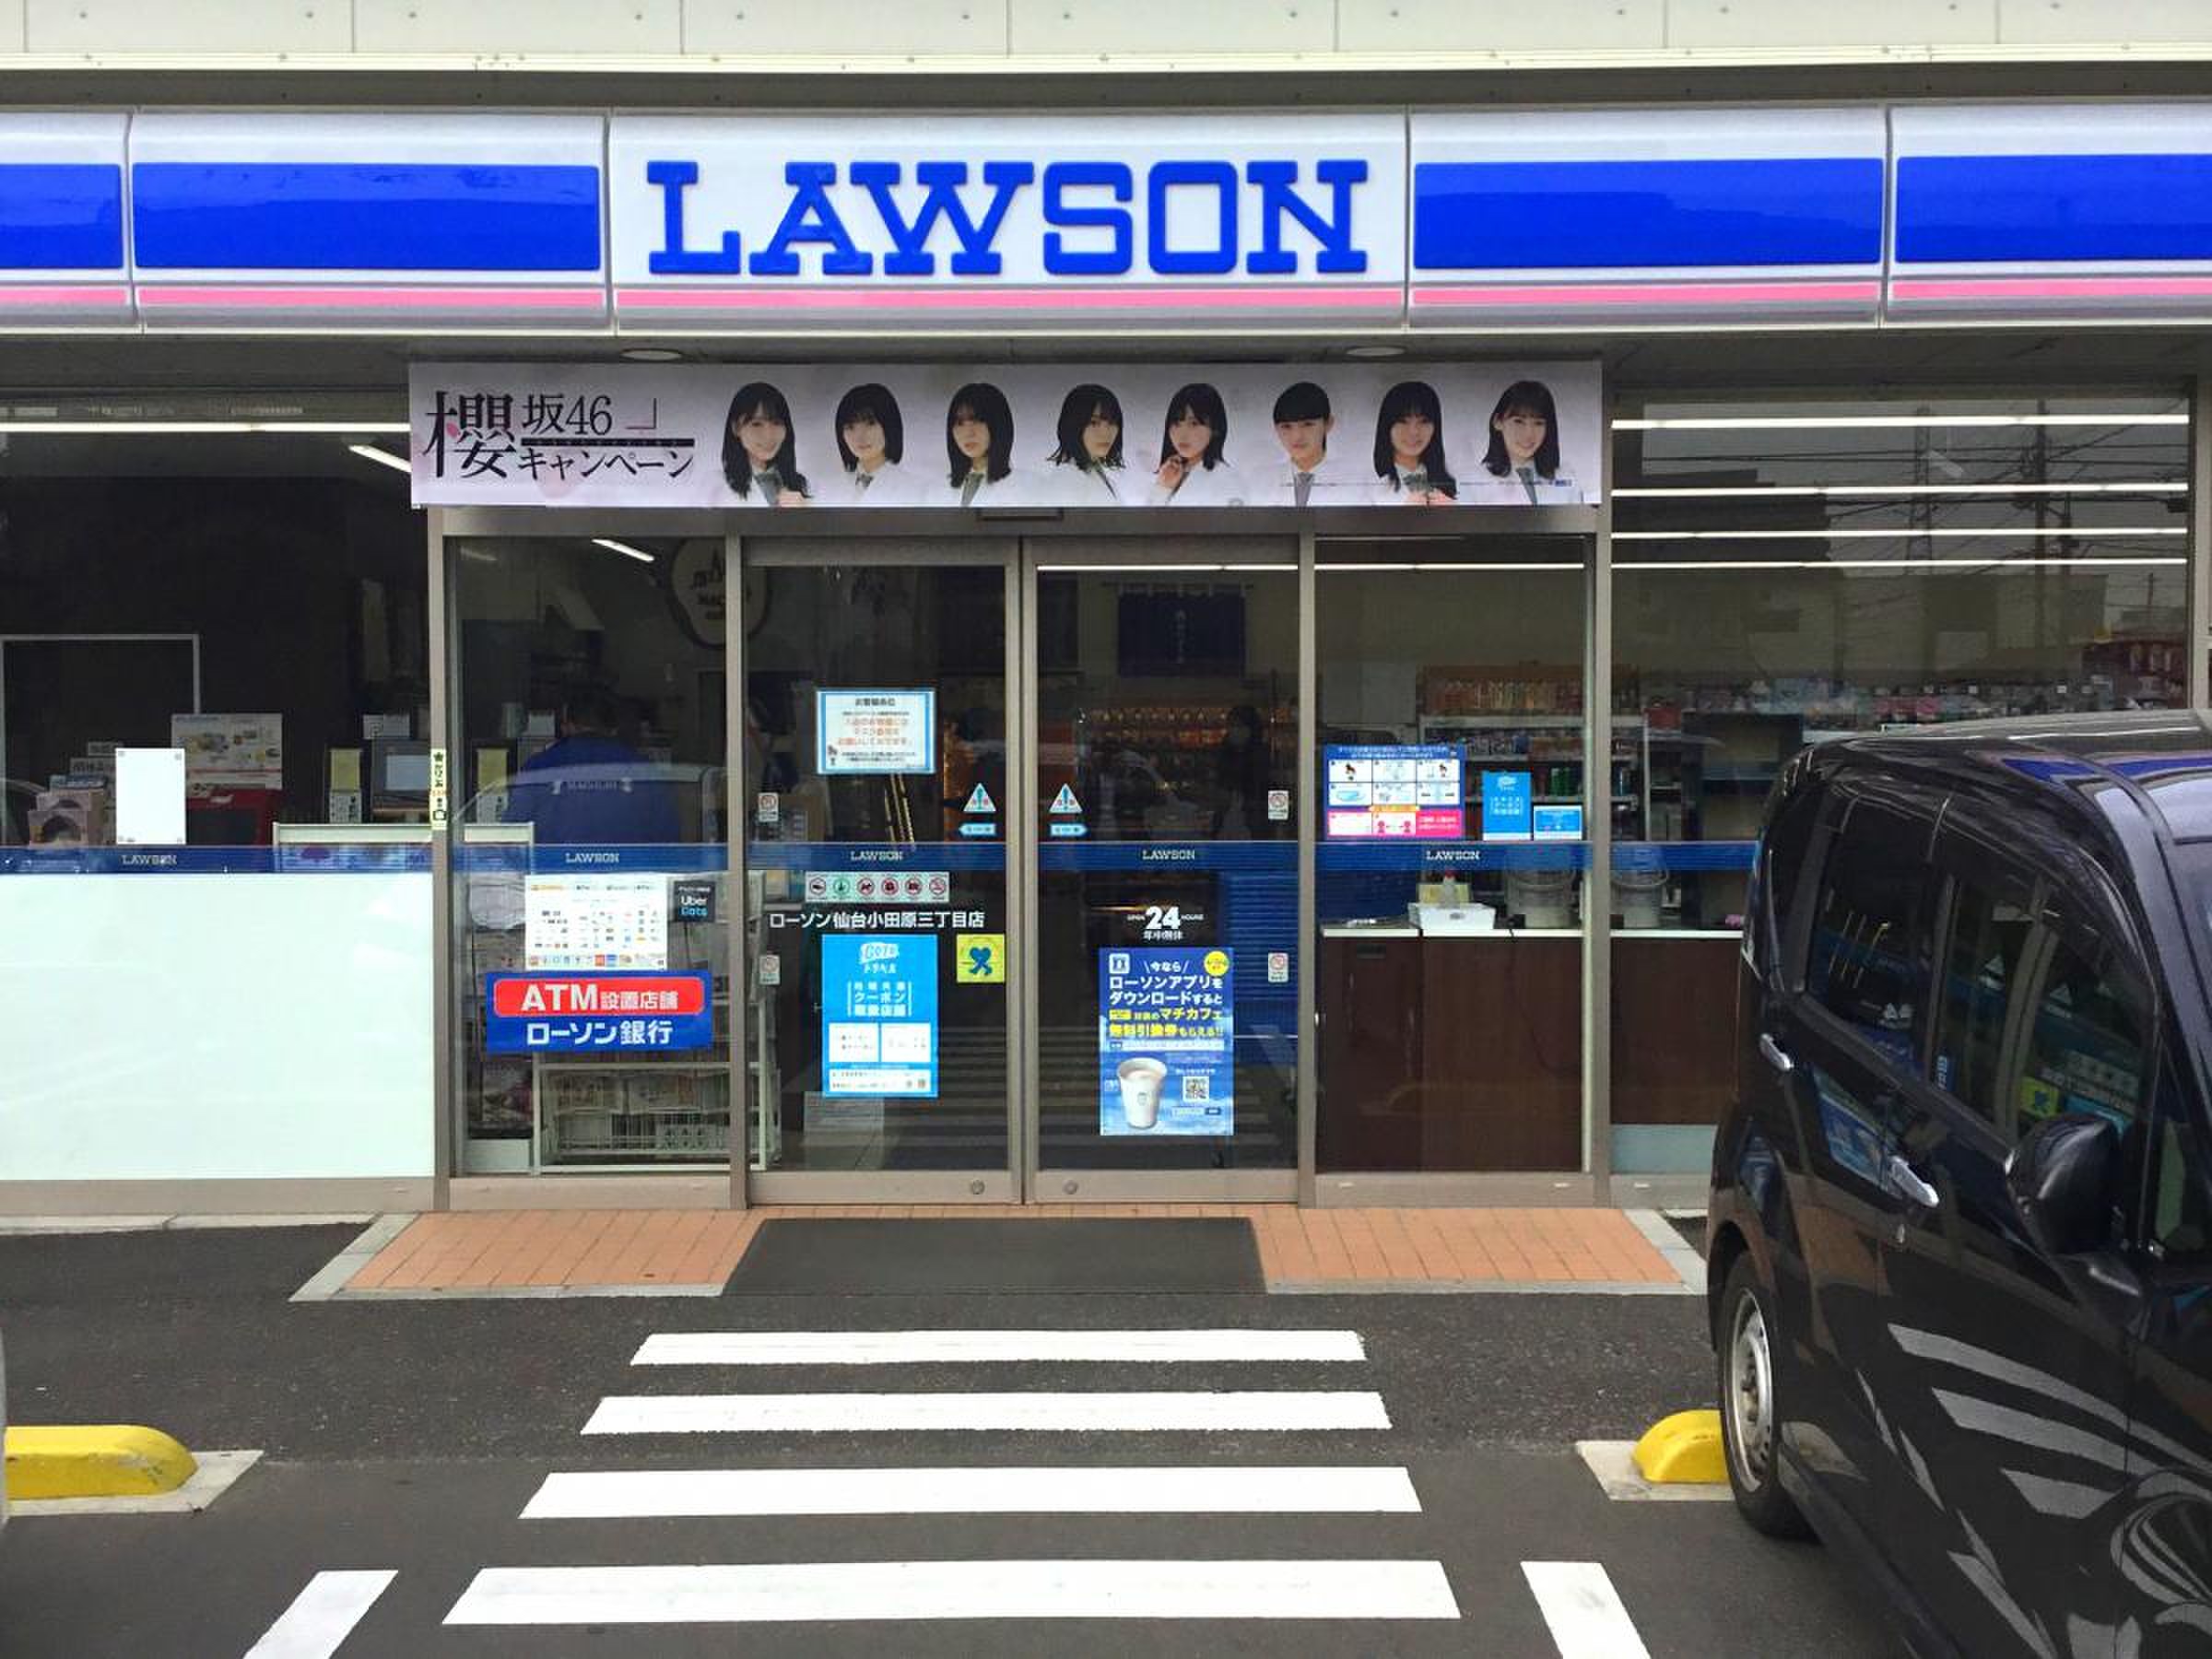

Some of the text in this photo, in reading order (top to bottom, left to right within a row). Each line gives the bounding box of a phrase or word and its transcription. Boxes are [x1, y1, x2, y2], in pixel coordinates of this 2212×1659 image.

[647, 159, 1369, 276] LAWSON
[421, 390, 614, 479] 櫻坂46
[518, 446, 695, 481] キャンペーン
[122, 854, 177, 865] LAWSON
[565, 853, 620, 864] LAWSON
[850, 850, 904, 861] LAWSON
[1142, 850, 1195, 861] LAWSON
[1426, 850, 1480, 861] LAWSON
[680, 895, 708, 906] Uber
[769, 911, 985, 929] ローソン仙台小田原三丁目店
[1145, 906, 1182, 930] 24
[1150, 961, 1181, 972] 今なら
[1109, 975, 1223, 990] ローソンアプリを
[1109, 991, 1223, 1006] ダウンロードすると
[526, 1020, 674, 1045] ローソン銀行
